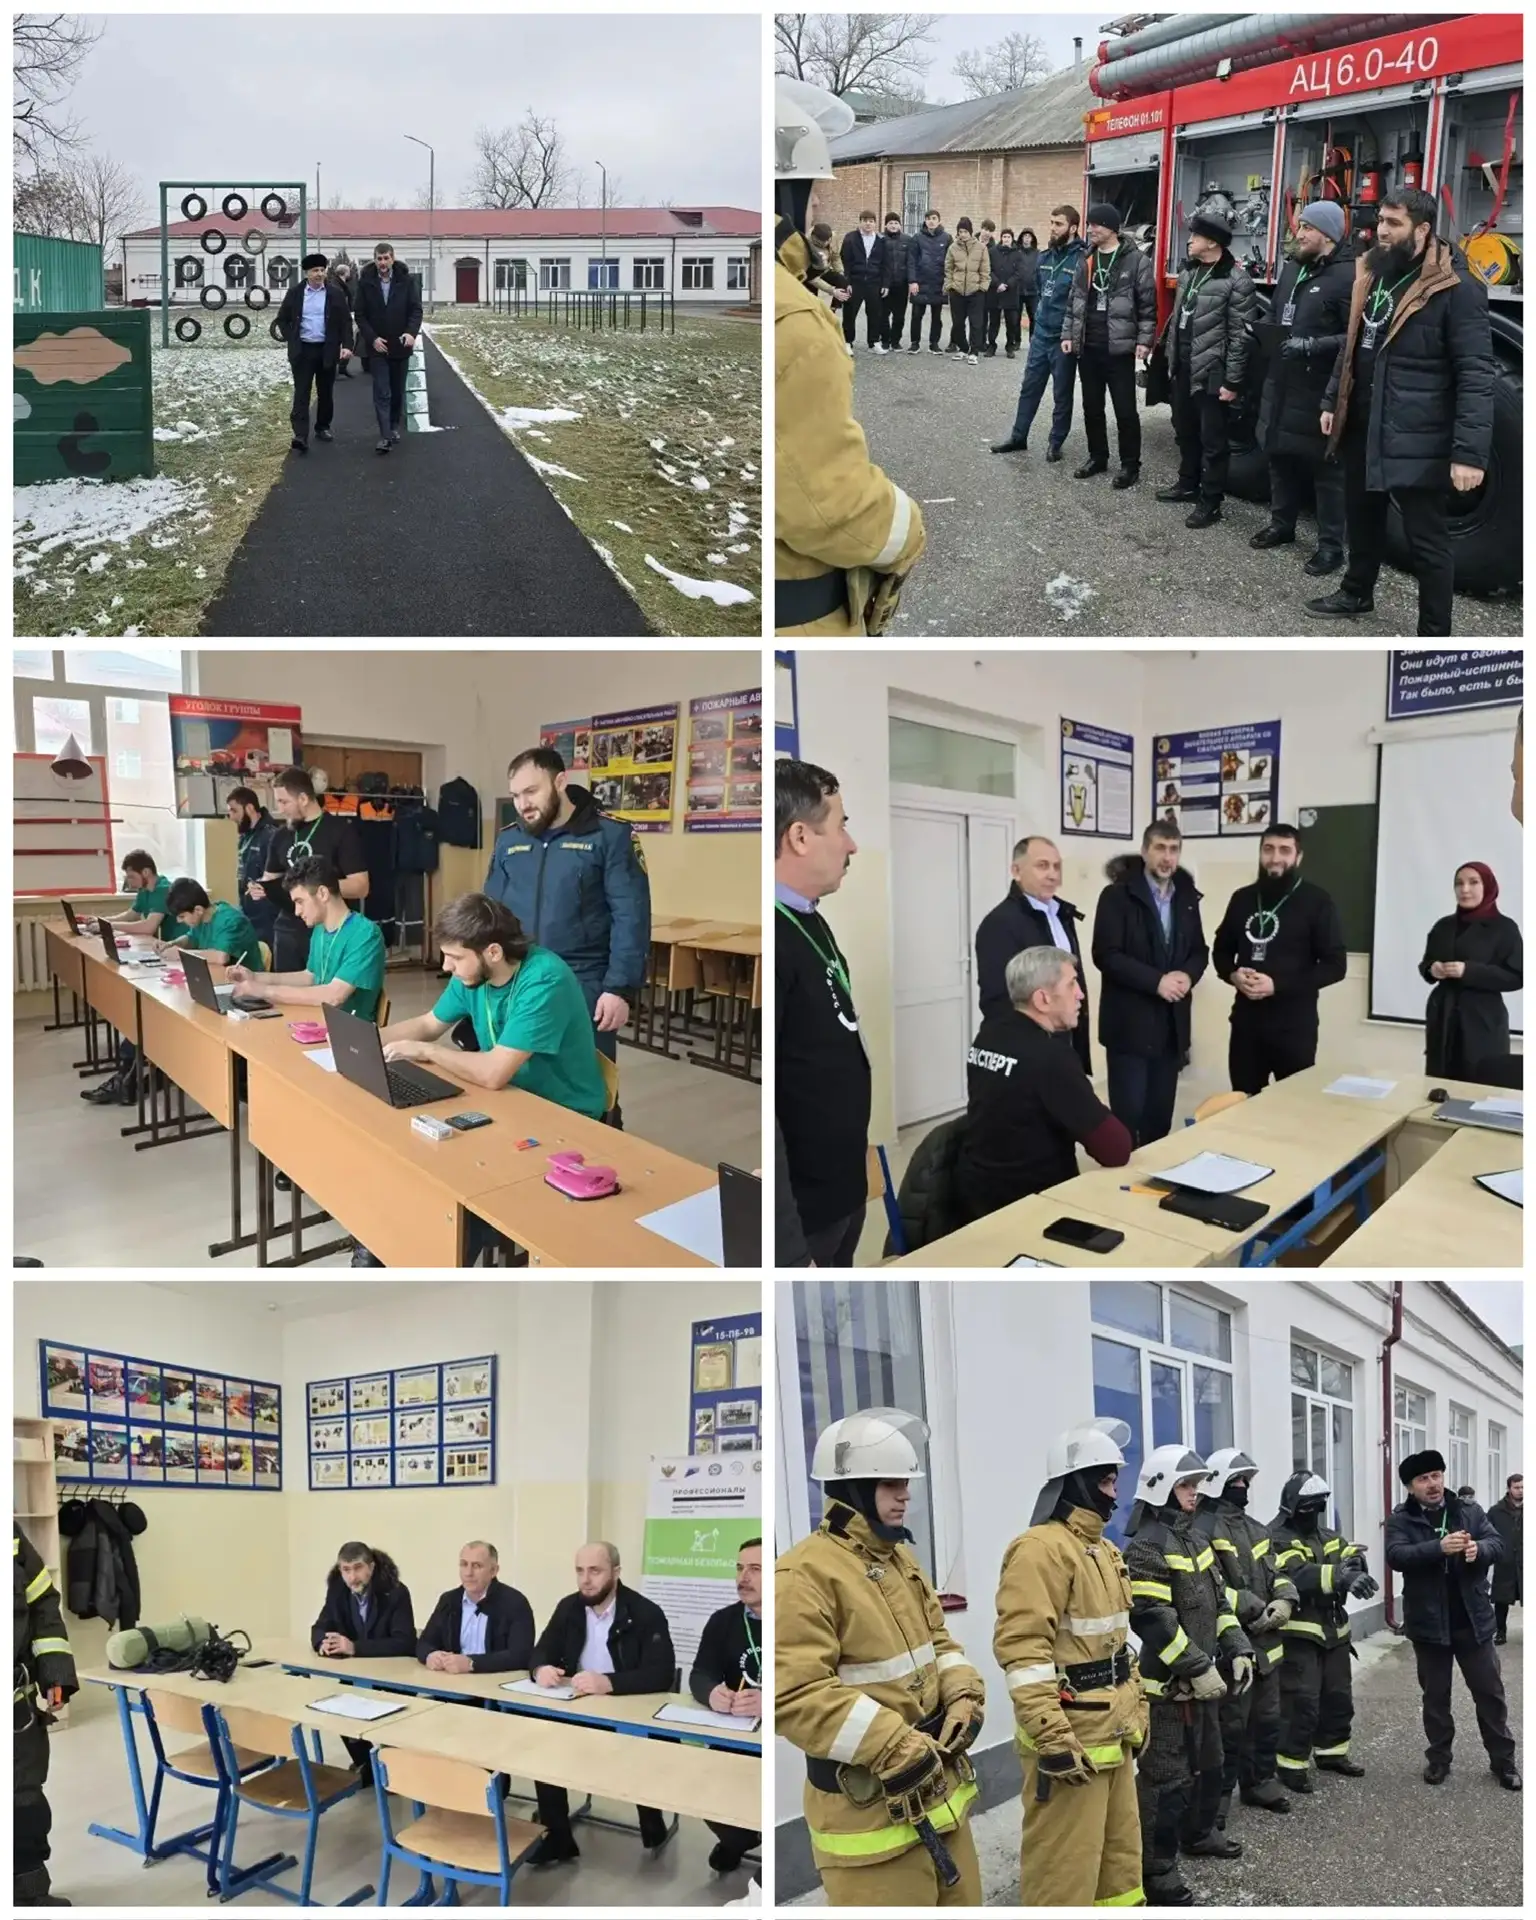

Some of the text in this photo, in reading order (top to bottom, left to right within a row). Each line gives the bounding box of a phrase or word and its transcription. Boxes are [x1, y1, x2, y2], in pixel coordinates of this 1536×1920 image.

[1288, 36, 1439, 96] АЦ 6.0-40
[1106, 109, 1163, 132] ТЕЛЕФОН 01.101
[1400, 660, 1423, 671] Они
[1425, 654, 1458, 668] идут
[1460, 652, 1468, 661] в
[1400, 690, 1419, 700] Так
[1420, 686, 1456, 698] было,
[1459, 680, 1492, 692] есть
[1495, 678, 1503, 687] и
[184, 699, 261, 716] УГОЛОК ГРУППЫ
[702, 692, 762, 711] ПОЖАРНЫЕ АВ
[672, 1486, 746, 1496] ПРОФЕССИОНАЛЫ
